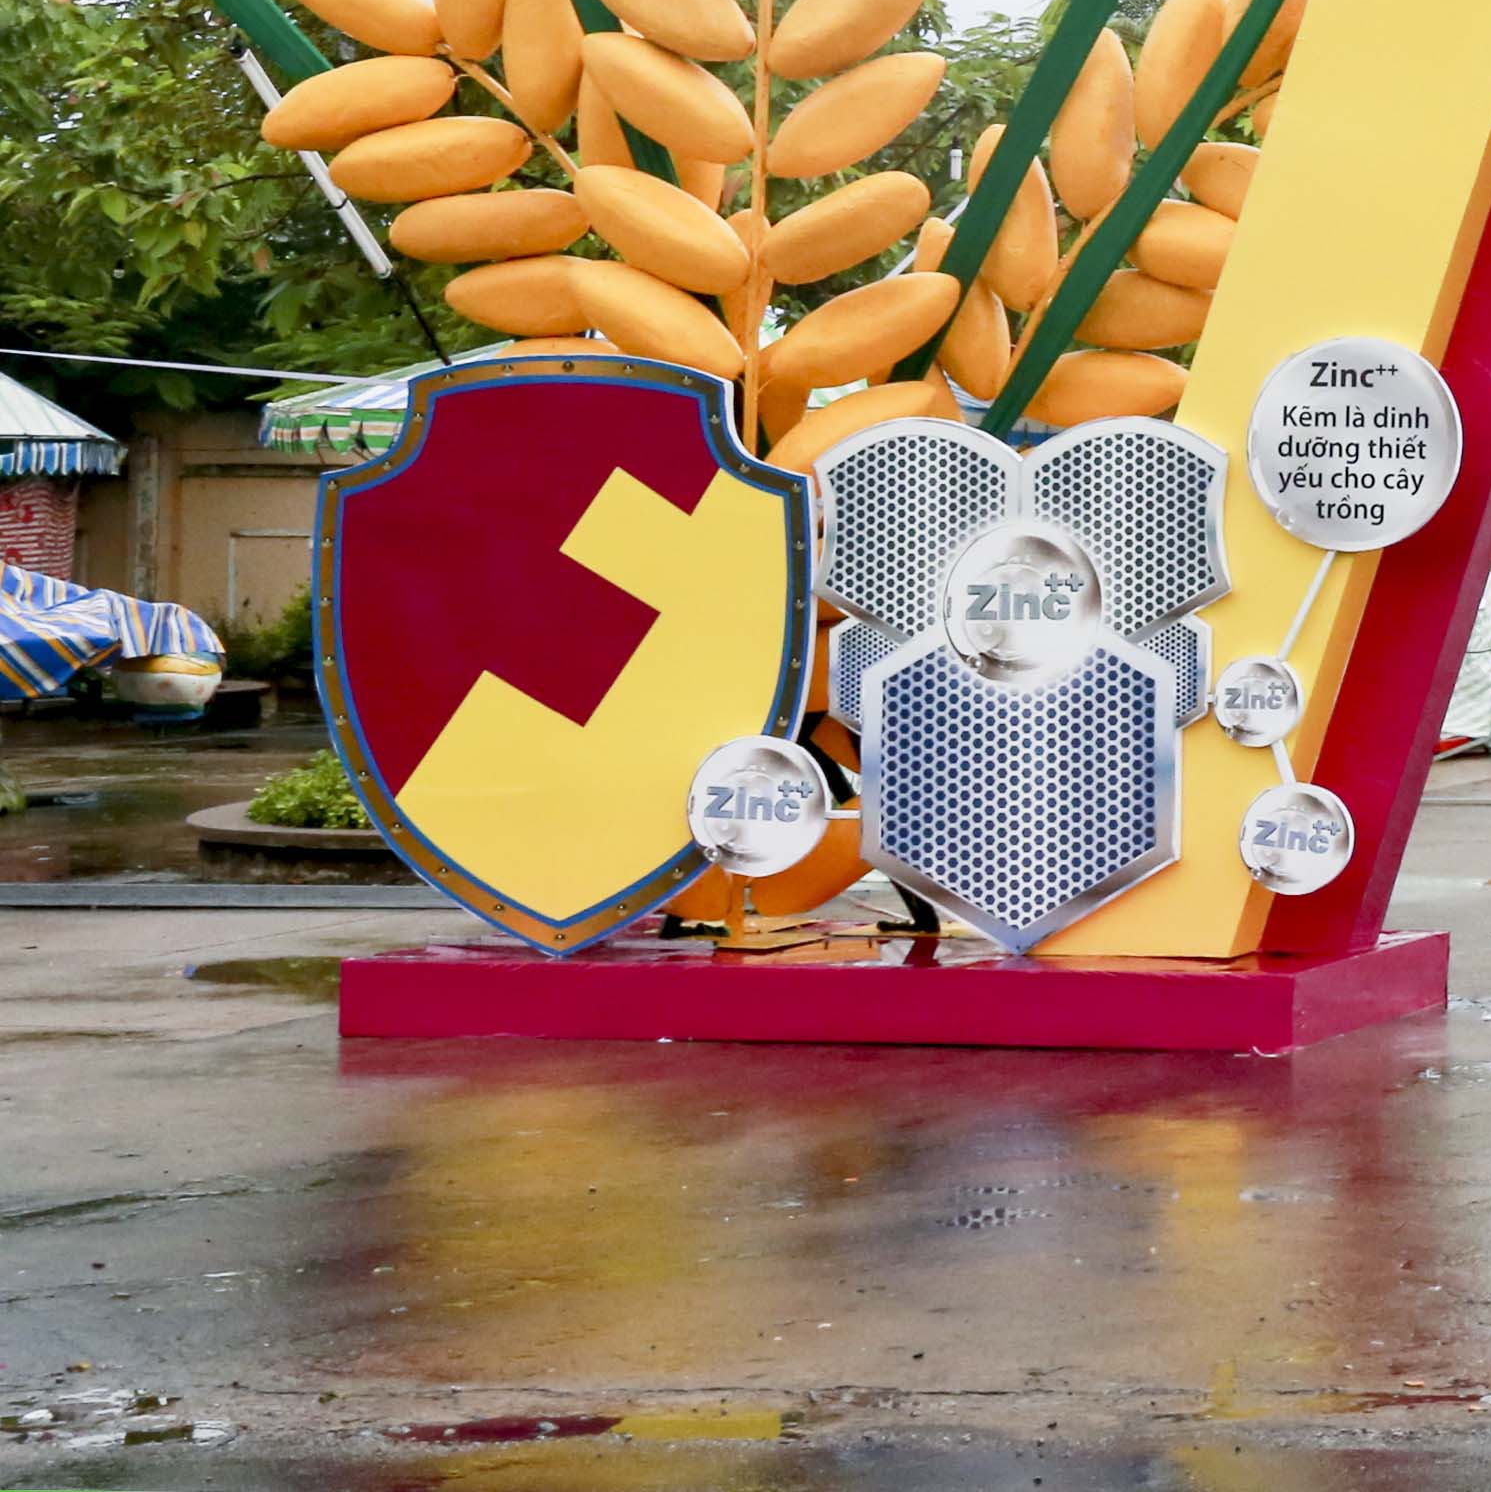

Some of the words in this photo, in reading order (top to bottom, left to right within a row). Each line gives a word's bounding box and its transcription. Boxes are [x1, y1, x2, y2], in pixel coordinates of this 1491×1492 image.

[1282, 405, 1337, 427] Kẽm
[1345, 405, 1365, 428] là
[1373, 406, 1430, 429] dinh
[1277, 435, 1360, 464] dưỡng
[1368, 434, 1427, 459] thiết
[1278, 463, 1323, 493] yếu
[1331, 467, 1376, 489] cho
[1383, 468, 1425, 495] cây
[1316, 494, 1385, 525] trồng
